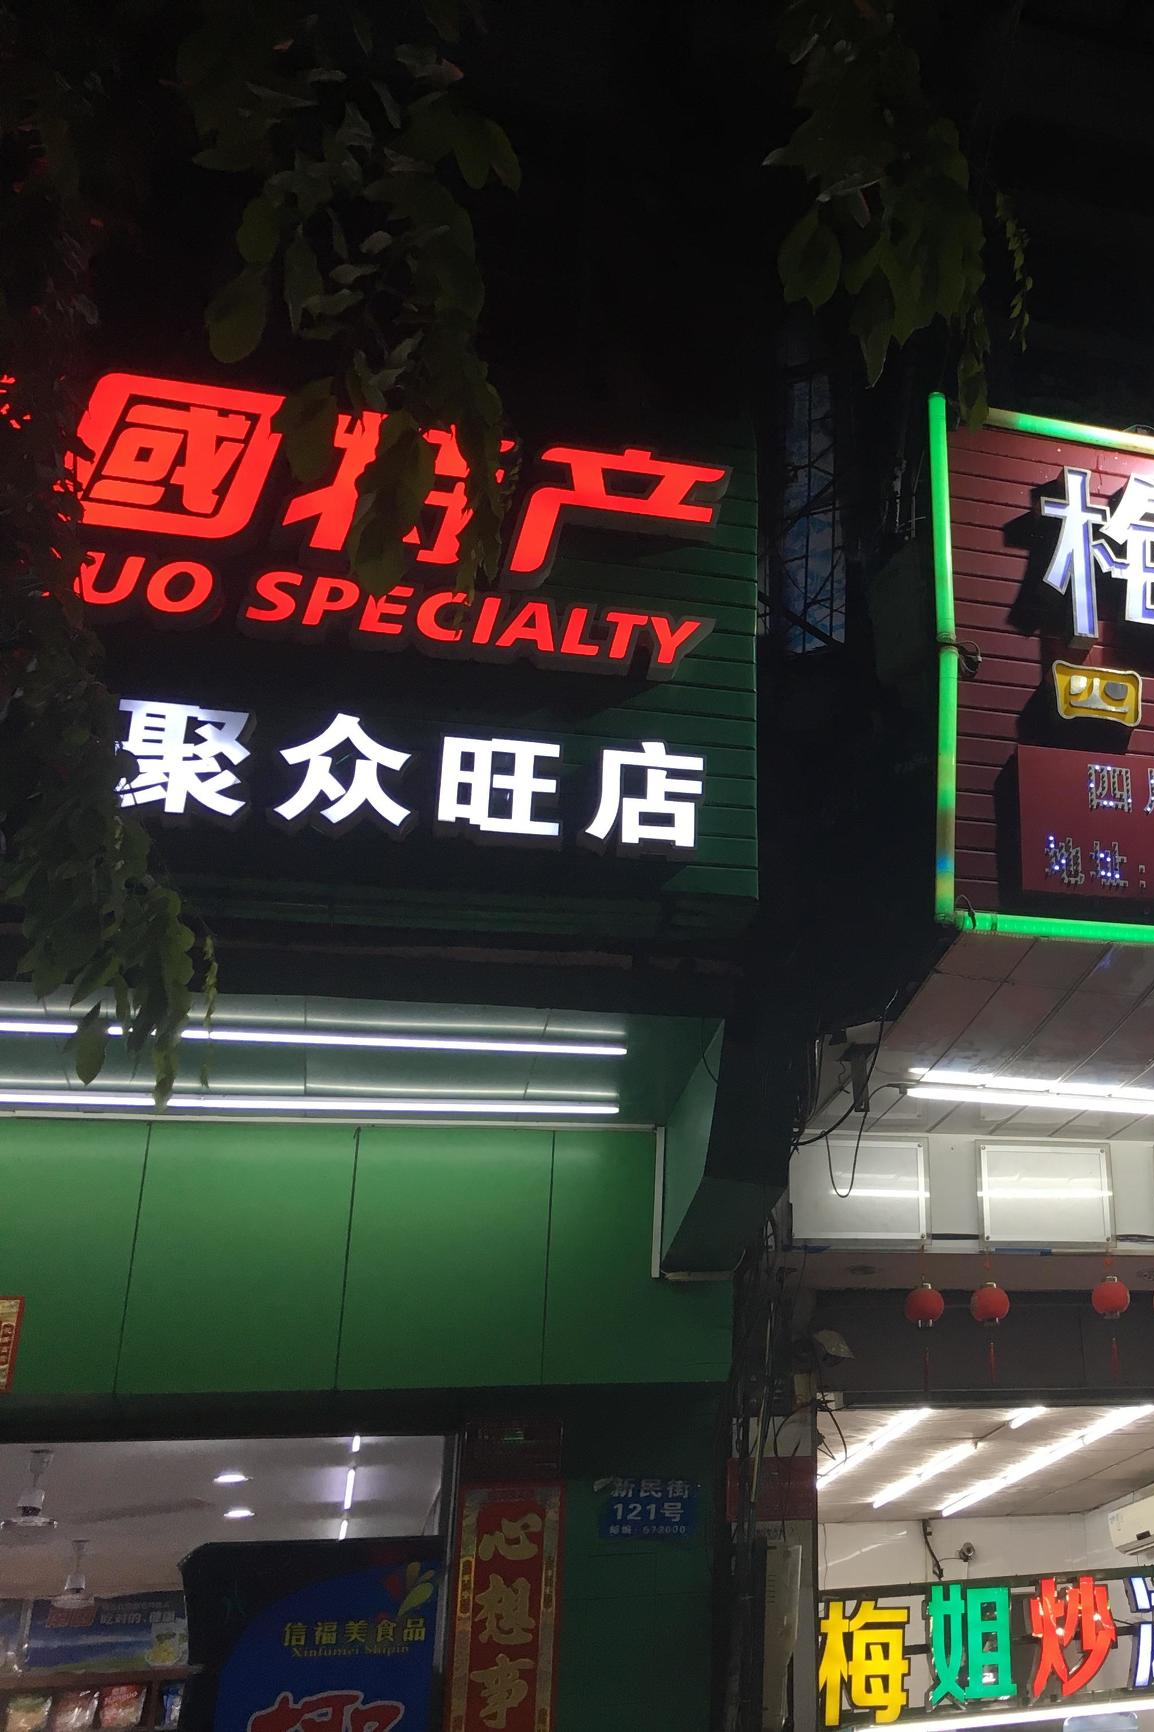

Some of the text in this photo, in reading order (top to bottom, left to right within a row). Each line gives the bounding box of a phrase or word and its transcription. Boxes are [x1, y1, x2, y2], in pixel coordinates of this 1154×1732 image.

[73, 551, 701, 664] UO SPECIALTY
[114, 698, 705, 847] 聚众旺店
[613, 1501, 684, 1522] 121号
[283, 1617, 426, 1647] 信福美食品
